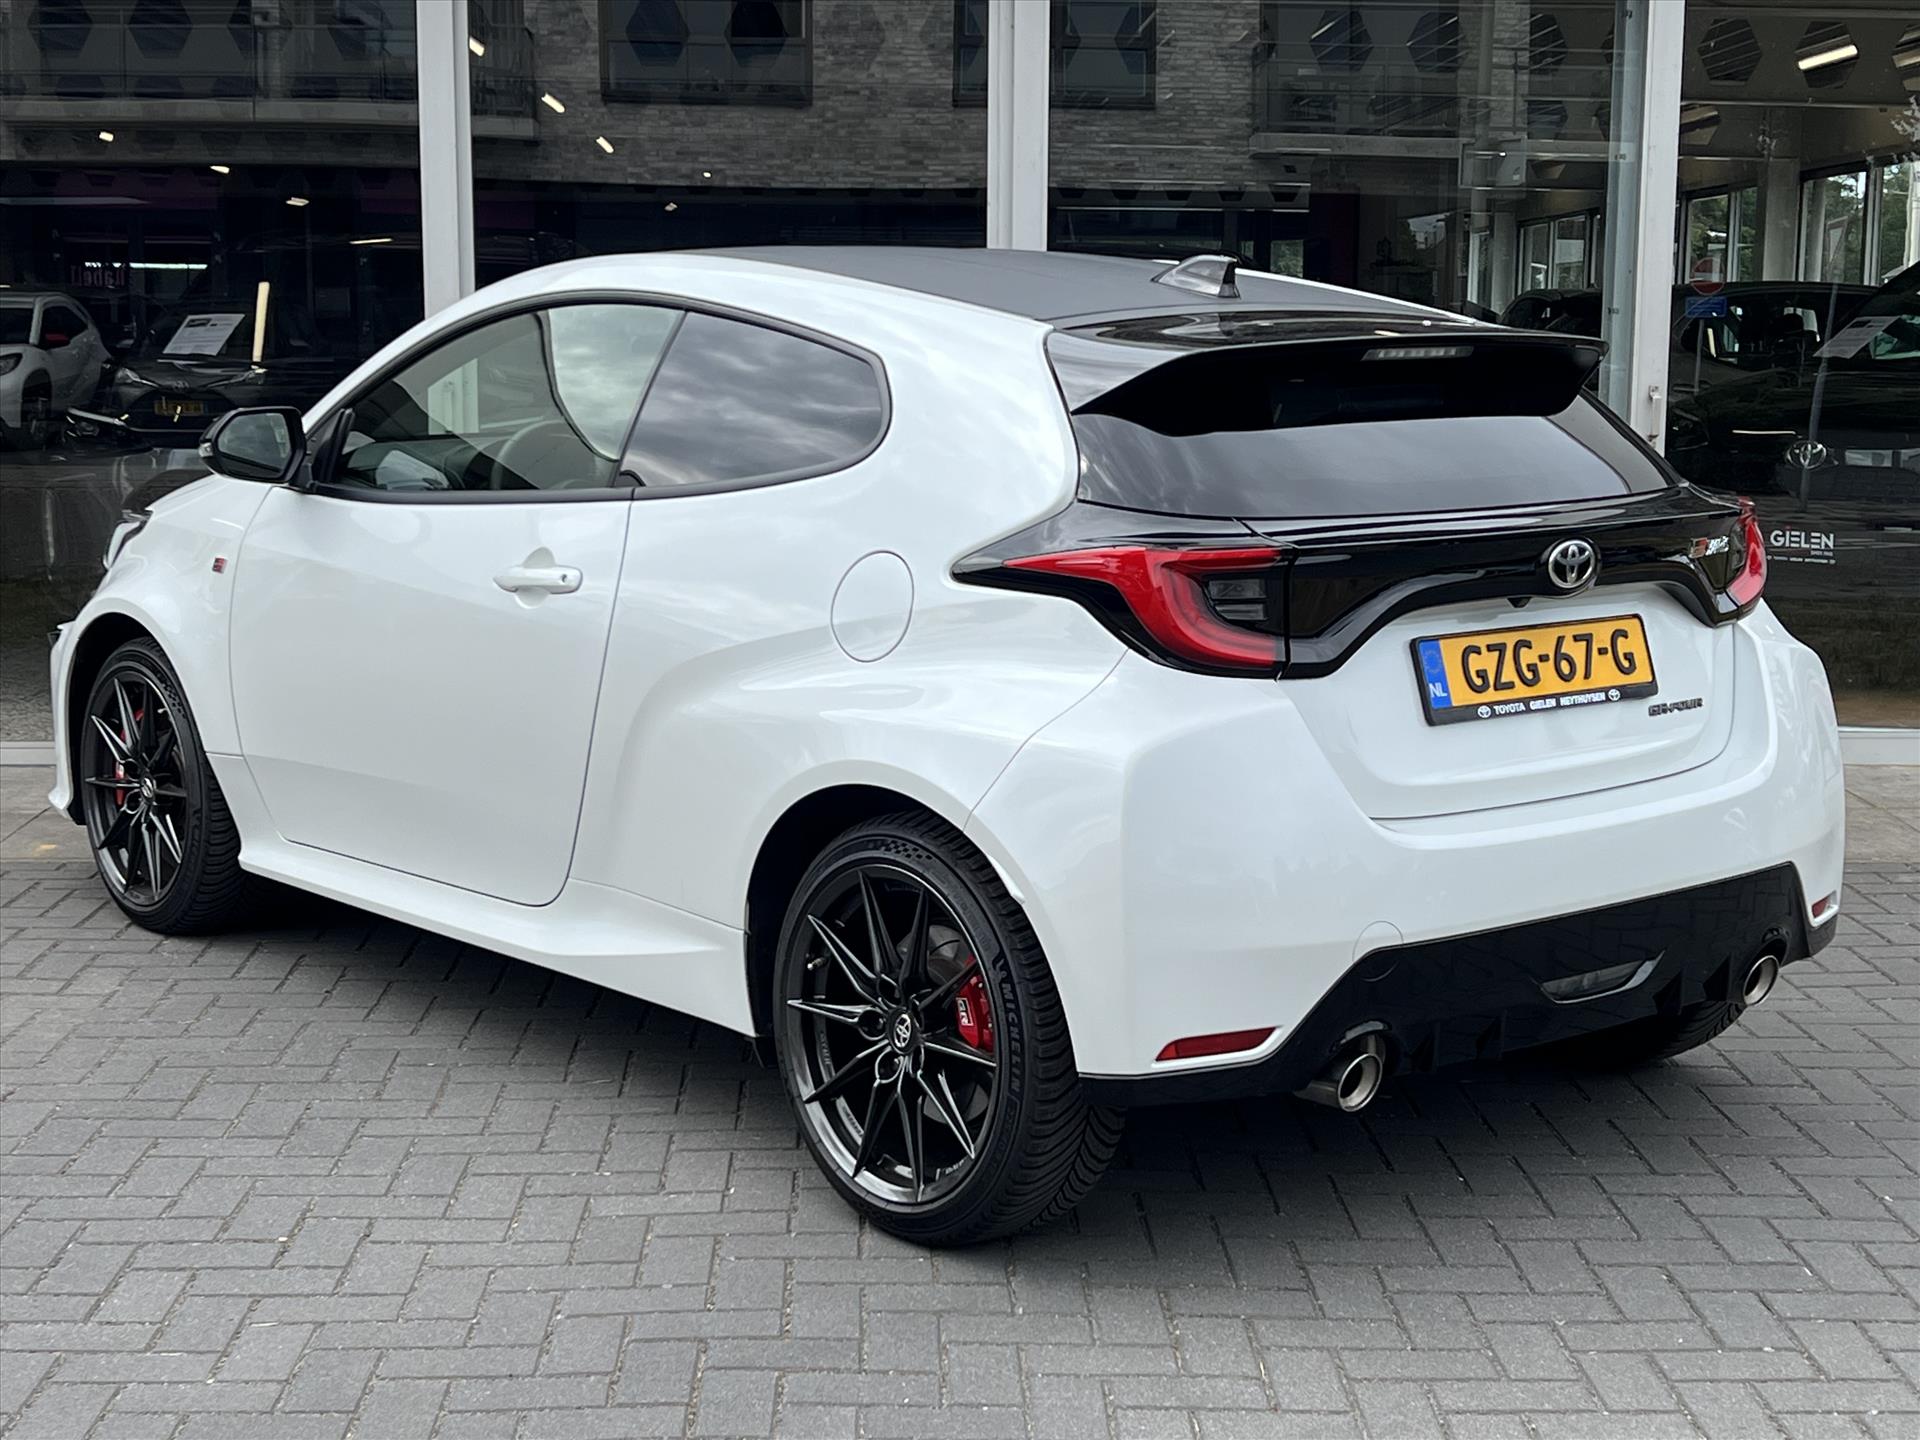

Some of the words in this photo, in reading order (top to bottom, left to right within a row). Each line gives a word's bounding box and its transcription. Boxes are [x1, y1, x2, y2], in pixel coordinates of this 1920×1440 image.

[1769, 530, 1834, 550] GIELEN
[1460, 628, 1638, 694] GZG-67-G
[1429, 682, 1448, 698] NL
[1493, 702, 1526, 715] TOYOTA
[1001, 984, 1022, 1093] MICHELIN
